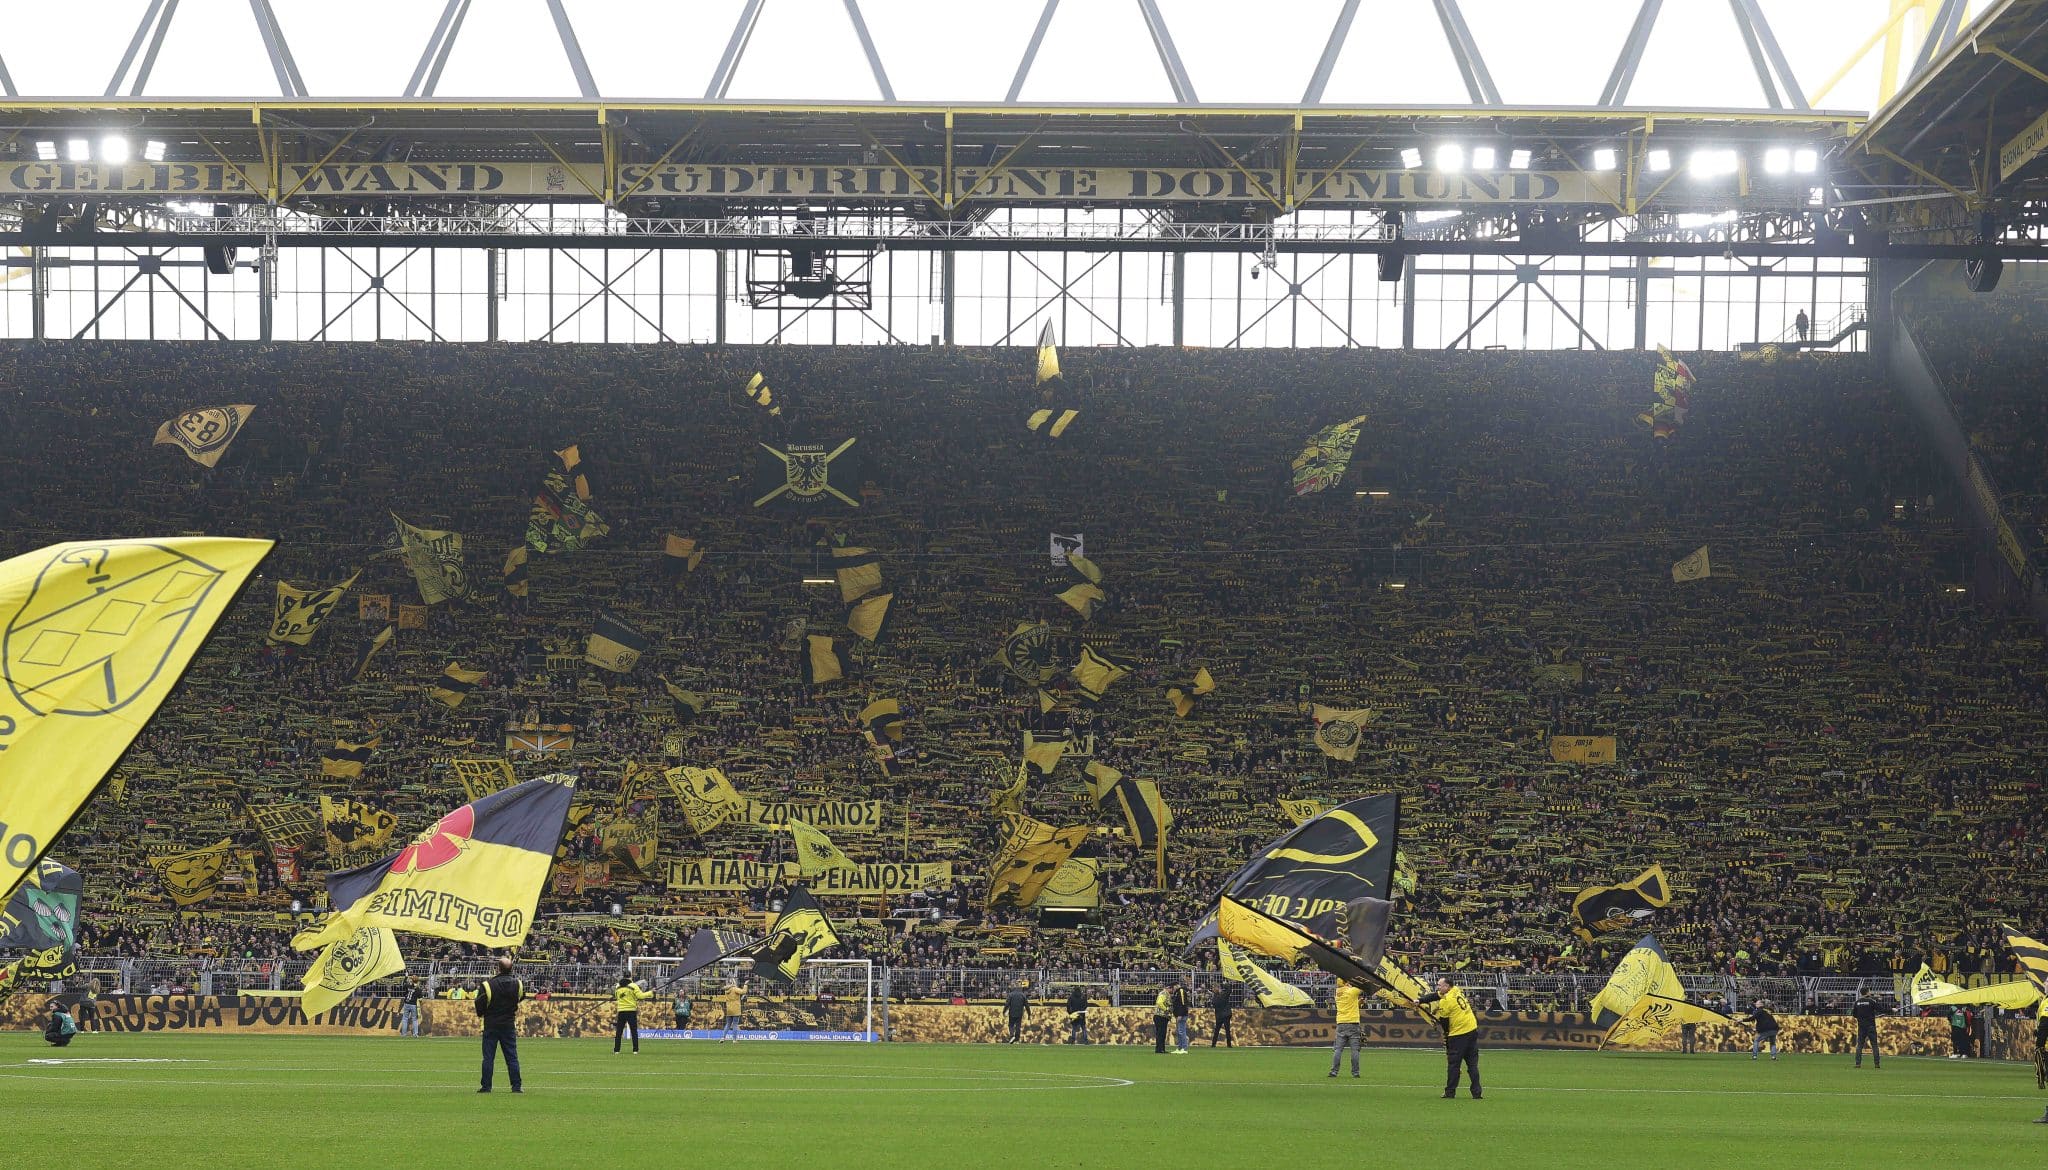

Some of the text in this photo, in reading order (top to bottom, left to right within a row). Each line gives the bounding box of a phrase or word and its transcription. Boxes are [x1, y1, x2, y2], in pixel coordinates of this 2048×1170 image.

[2002, 125, 2044, 169] SIGNAL IDUNA
[10, 164, 504, 191] GELBE WAND
[1128, 169, 1560, 199] DORTMUND
[1290, 802, 1313, 817] VB
[669, 859, 704, 885] ΓΙΑ
[812, 864, 919, 890] ΡΕΙΑΝΟΣ!
[1365, 1024, 1442, 1040] Neve
[1541, 1028, 1601, 1043] Alon
